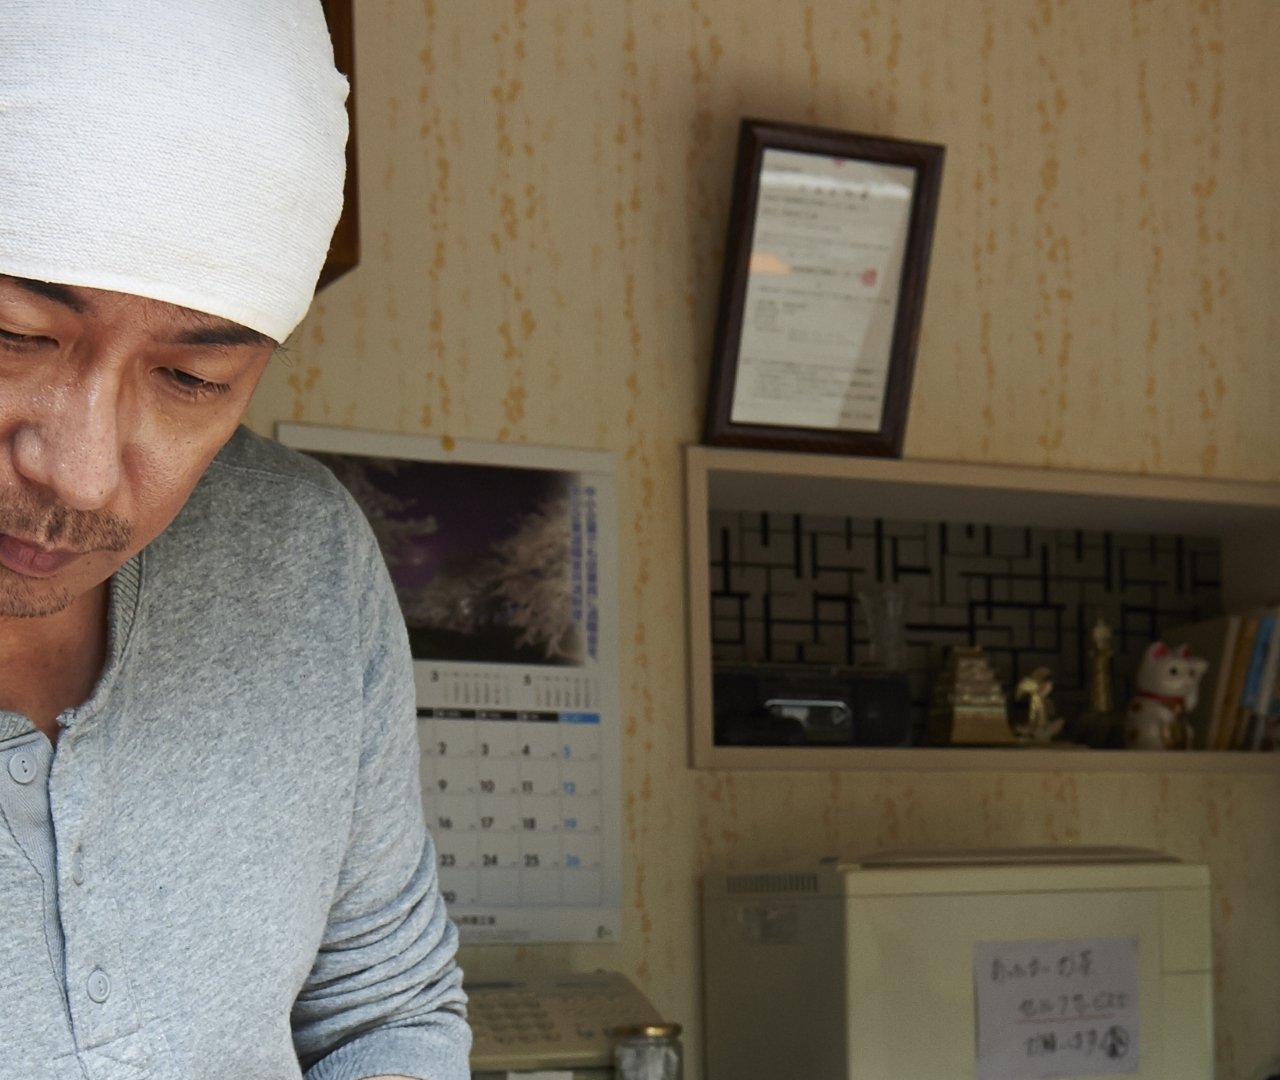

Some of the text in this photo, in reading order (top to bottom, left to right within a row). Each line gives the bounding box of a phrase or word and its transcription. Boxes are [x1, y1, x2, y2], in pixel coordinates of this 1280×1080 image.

[480, 780, 495, 793] 10
[522, 781, 534, 793] 11
[438, 817, 453, 830] 16
[481, 817, 495, 830] 17
[523, 817, 536, 830] 18
[440, 854, 455, 867] 23
[482, 855, 498, 867] 24
[524, 855, 539, 867] 25
